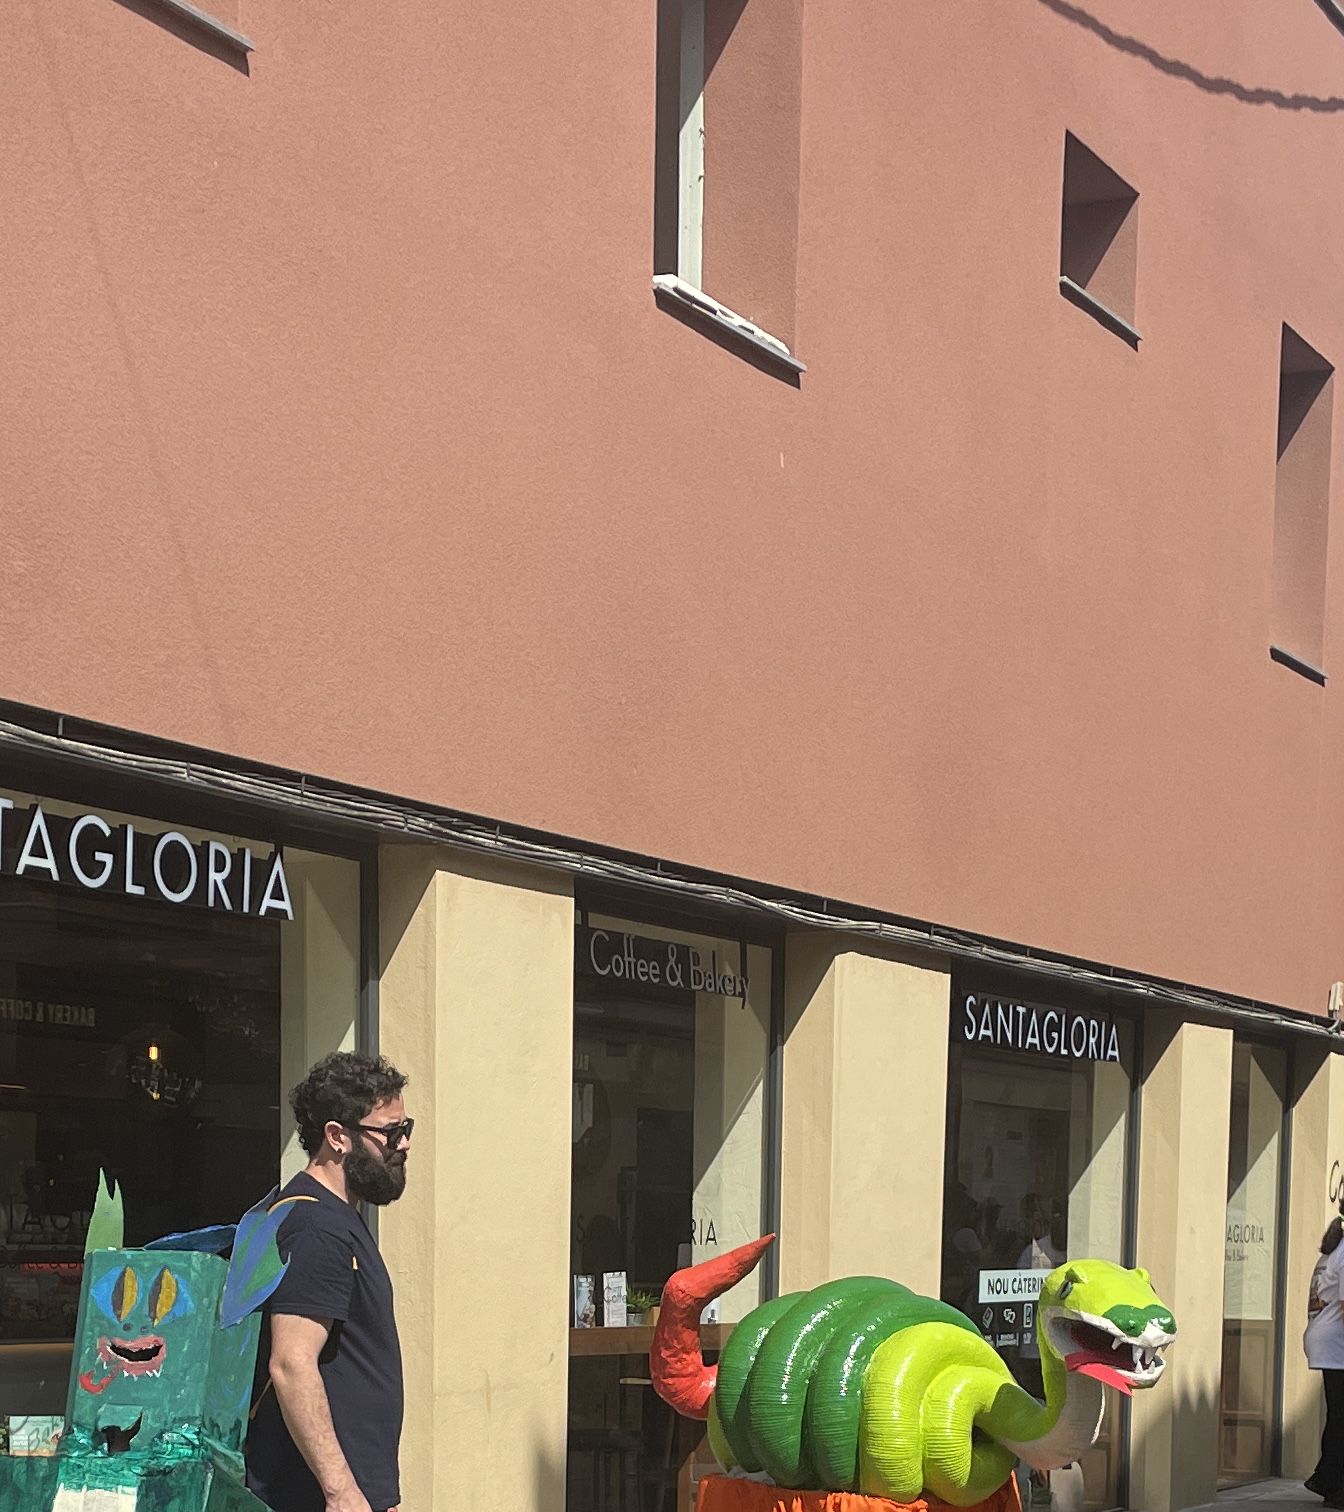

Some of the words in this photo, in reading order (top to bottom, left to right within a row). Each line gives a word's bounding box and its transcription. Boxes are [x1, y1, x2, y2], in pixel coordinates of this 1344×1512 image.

[590, 930, 661, 984] Coffee
[666, 943, 684, 989] &
[689, 947, 750, 1008] Bakery
[964, 995, 1121, 1063] SANTAGLORIA
[987, 1278, 1009, 1296] NOU
